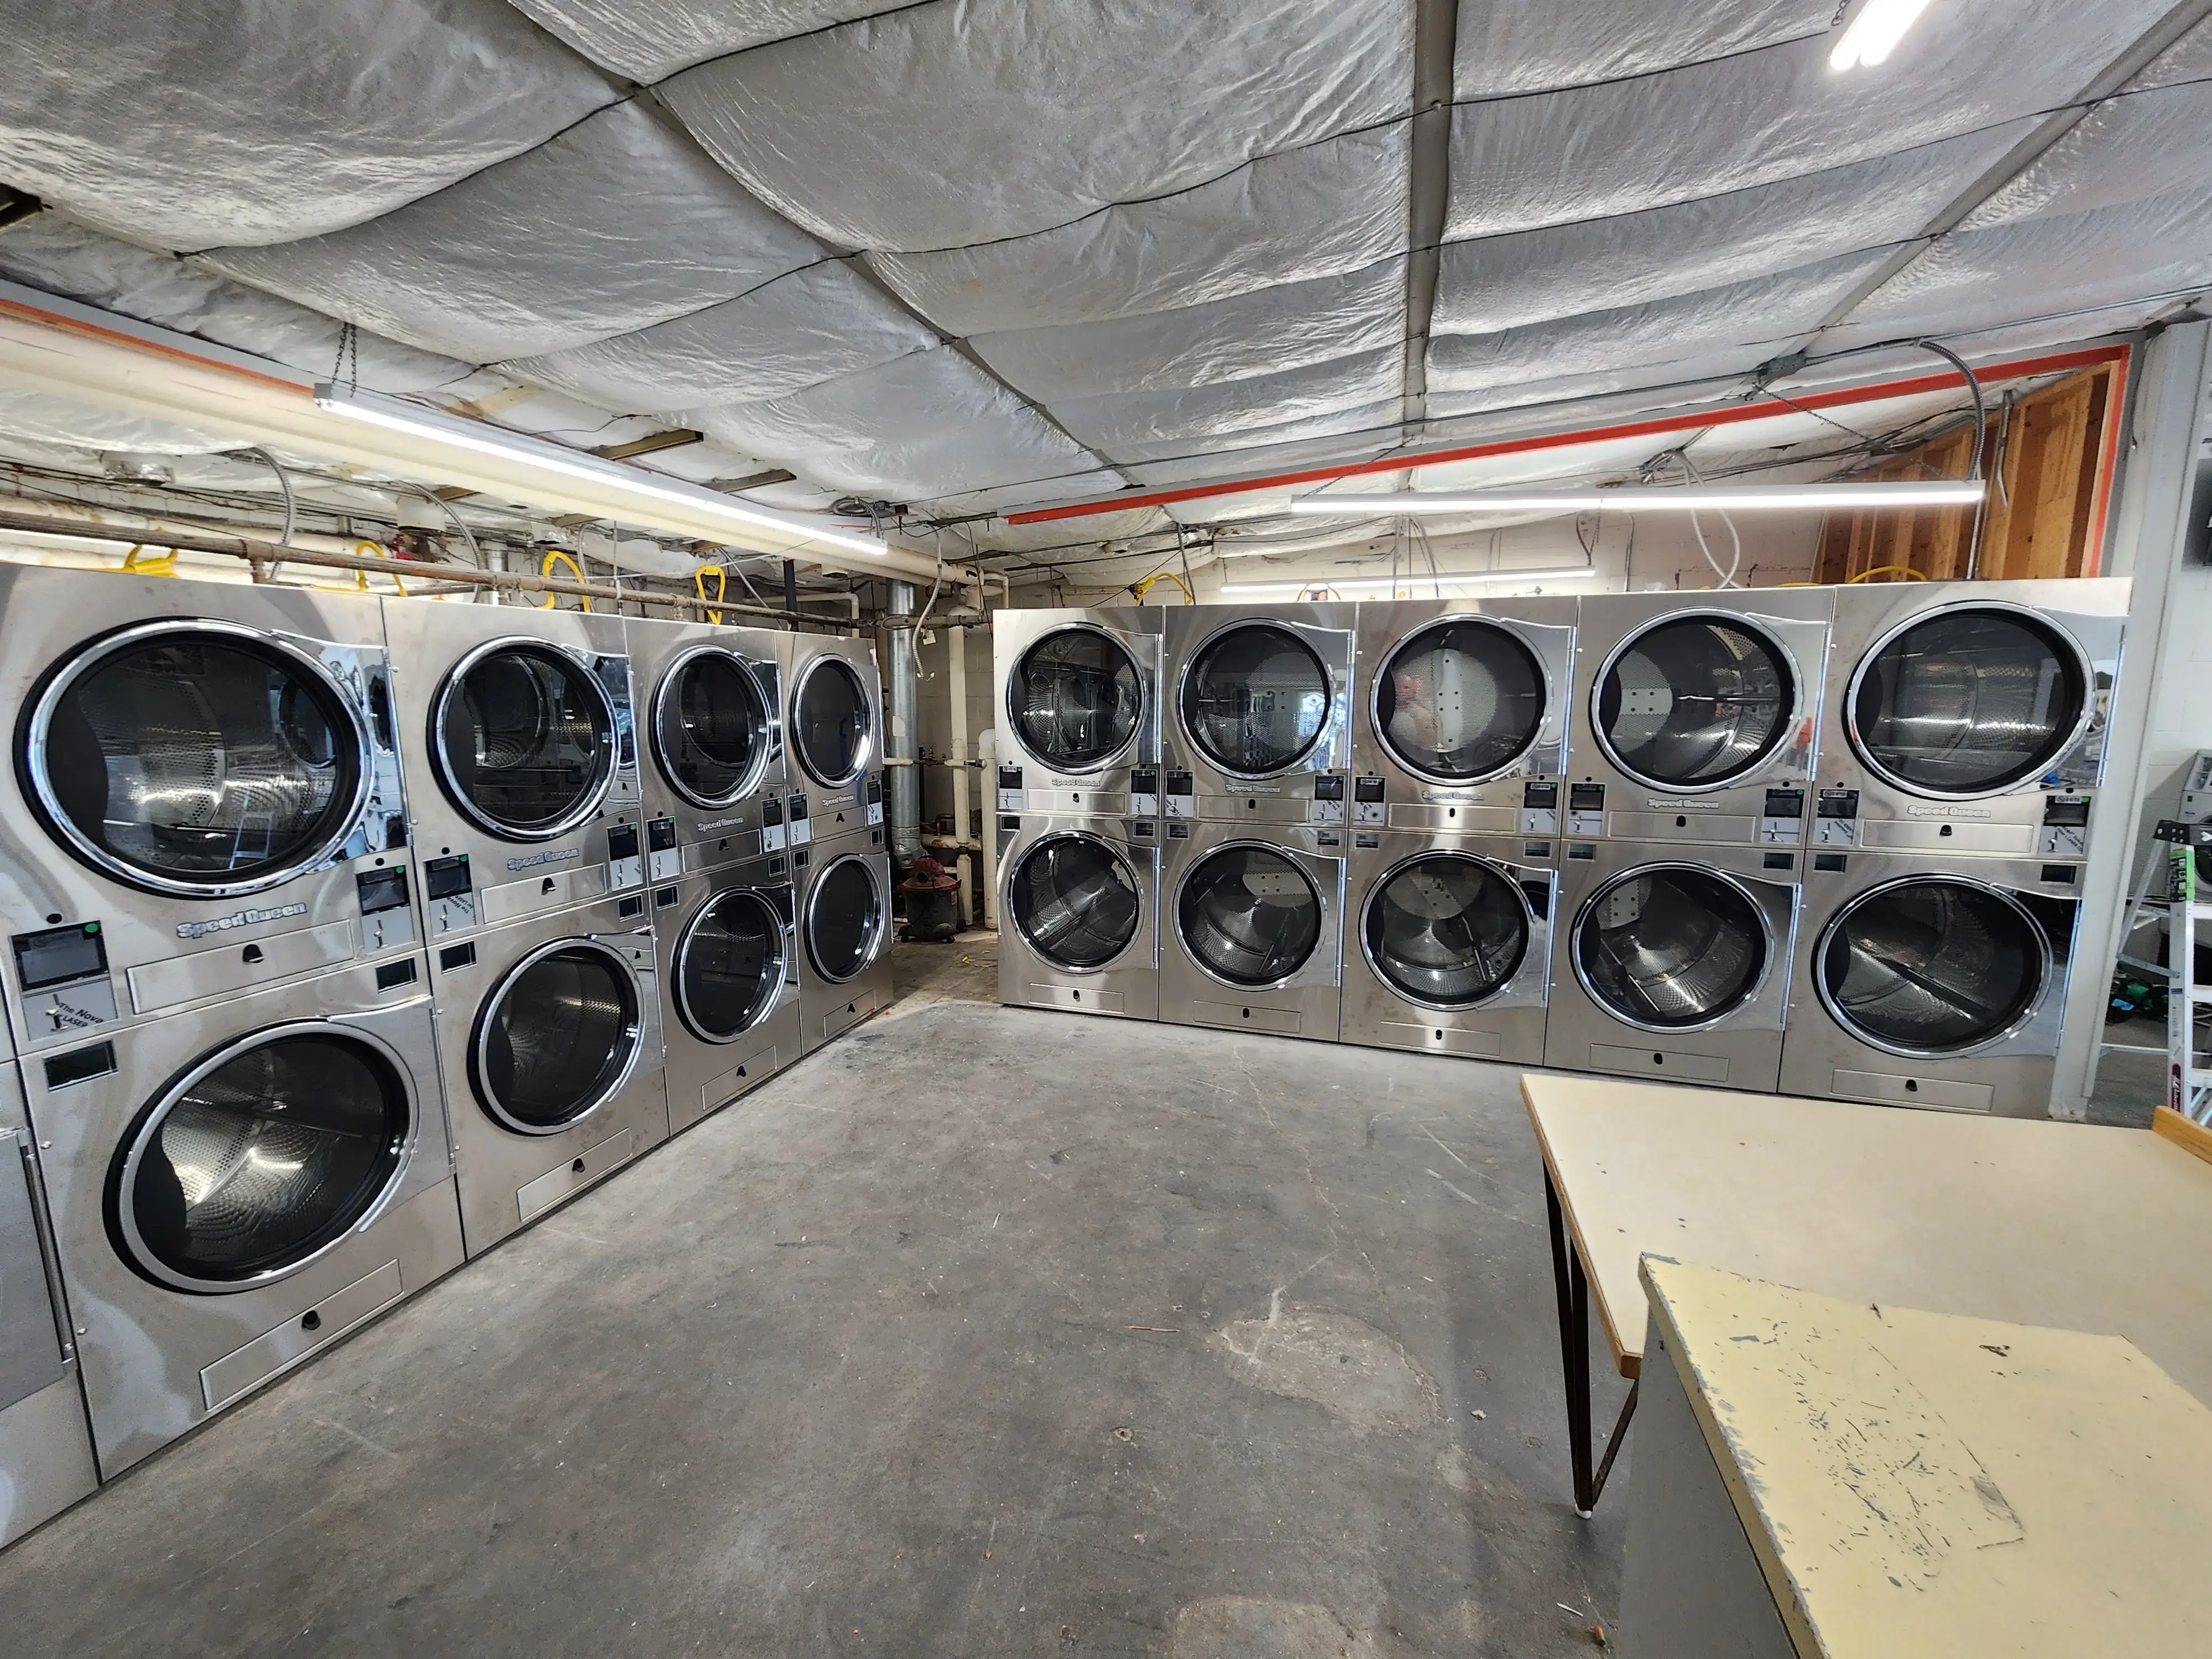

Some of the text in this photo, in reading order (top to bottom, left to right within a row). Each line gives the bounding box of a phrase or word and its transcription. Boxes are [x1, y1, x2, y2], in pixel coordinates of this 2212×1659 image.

[1052, 778, 1076, 786] Speed
[1225, 784, 1252, 793] Speed
[822, 796, 838, 807] Speed
[1647, 798, 1683, 808] Speed
[1907, 805, 1991, 817] Speed Queen
[697, 816, 744, 833] Speed Queen
[507, 848, 579, 871] Speed Queen
[176, 902, 307, 939] Speed Queen
[59, 1002, 103, 1024] The Nova
